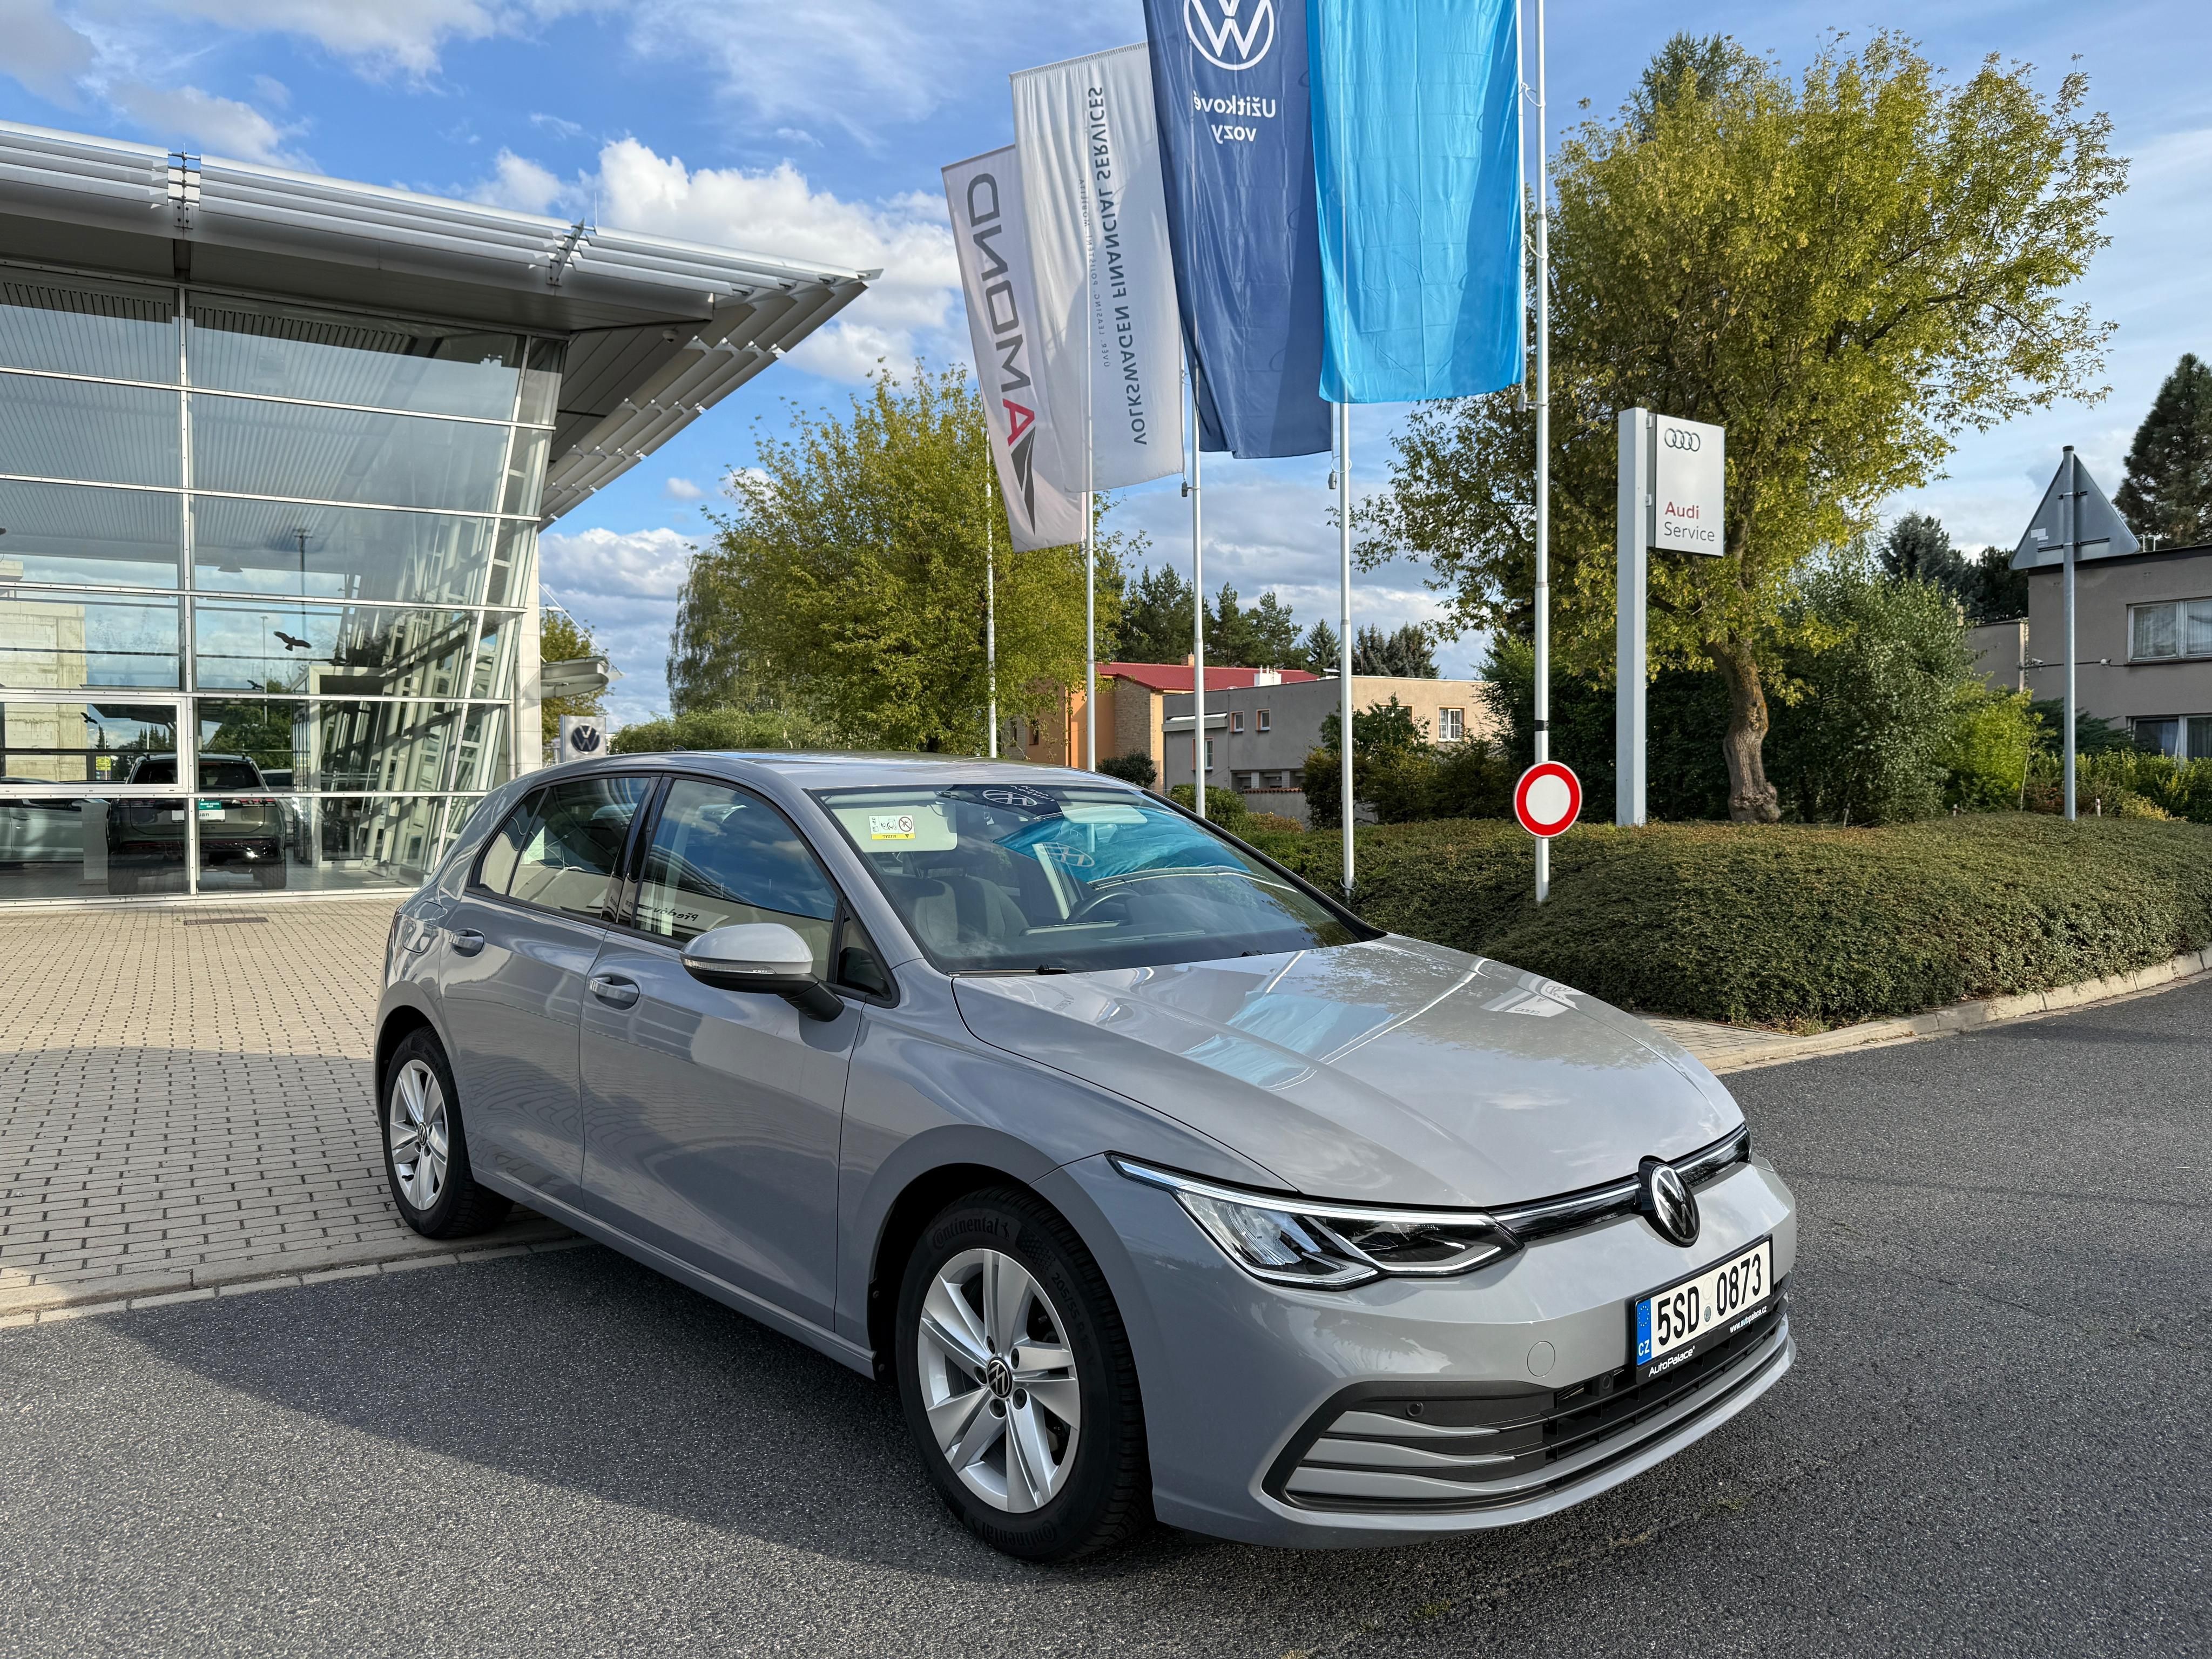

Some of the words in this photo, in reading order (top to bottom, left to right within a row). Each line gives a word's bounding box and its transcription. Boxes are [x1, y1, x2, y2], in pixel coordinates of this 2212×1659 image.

[1664, 501, 1700, 520] Audi
[1664, 521, 1715, 542] Service
[933, 1217, 999, 1249] Continental
[1657, 1286, 1700, 1346] 5SD
[1717, 1253, 1762, 1317] 0873
[1638, 1339, 1650, 1357] CZ
